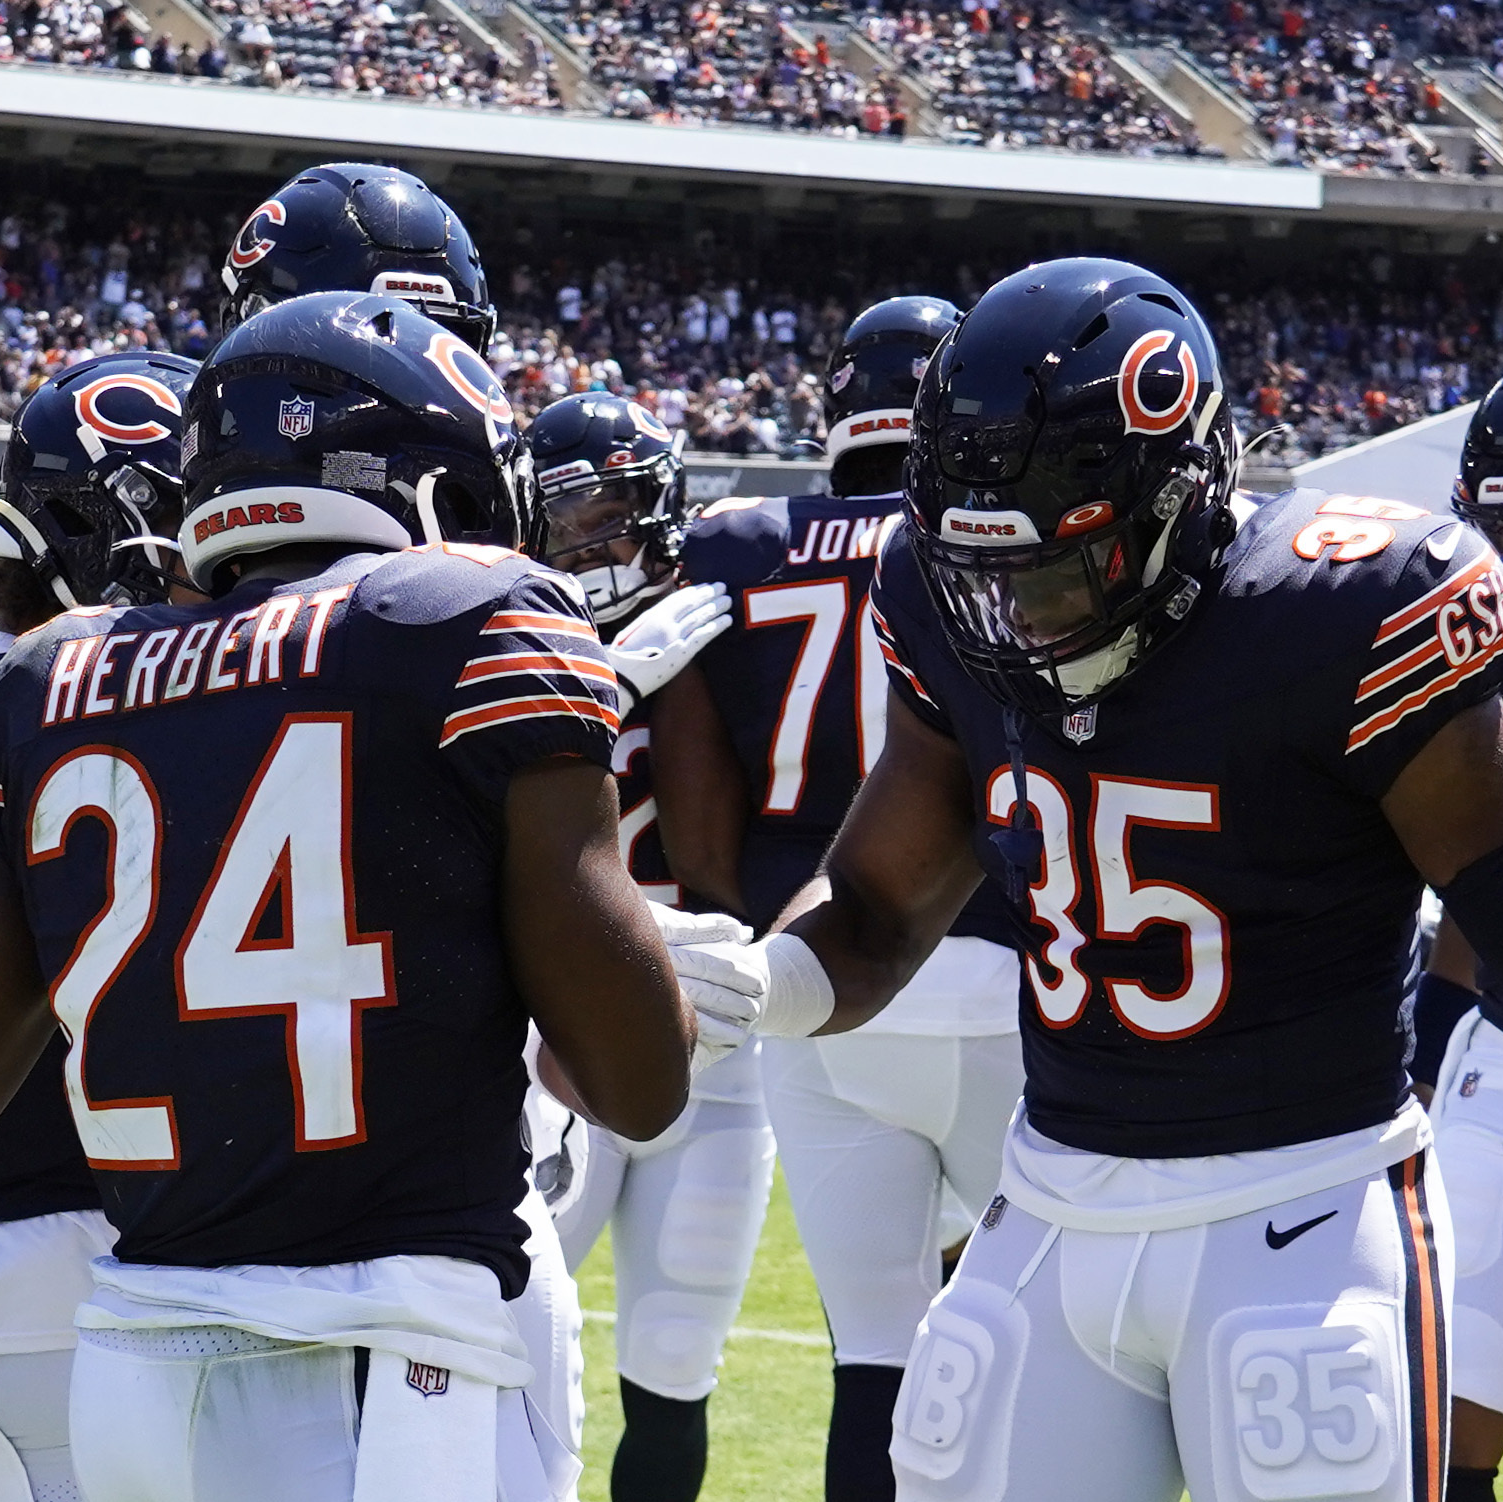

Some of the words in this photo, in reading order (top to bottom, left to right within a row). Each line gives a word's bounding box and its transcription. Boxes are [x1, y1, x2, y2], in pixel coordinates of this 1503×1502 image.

[386, 280, 444, 294] BEARS
[850, 418, 913, 436] BEAR
[194, 502, 305, 545] BEARS
[949, 519, 1017, 536] BEARS
[41, 583, 355, 727] HERBERT
[986, 763, 1232, 1041] 35
[27, 711, 397, 1171] 24
[410, 1362, 445, 1392] NFL
[1238, 1349, 1381, 1471] 35
